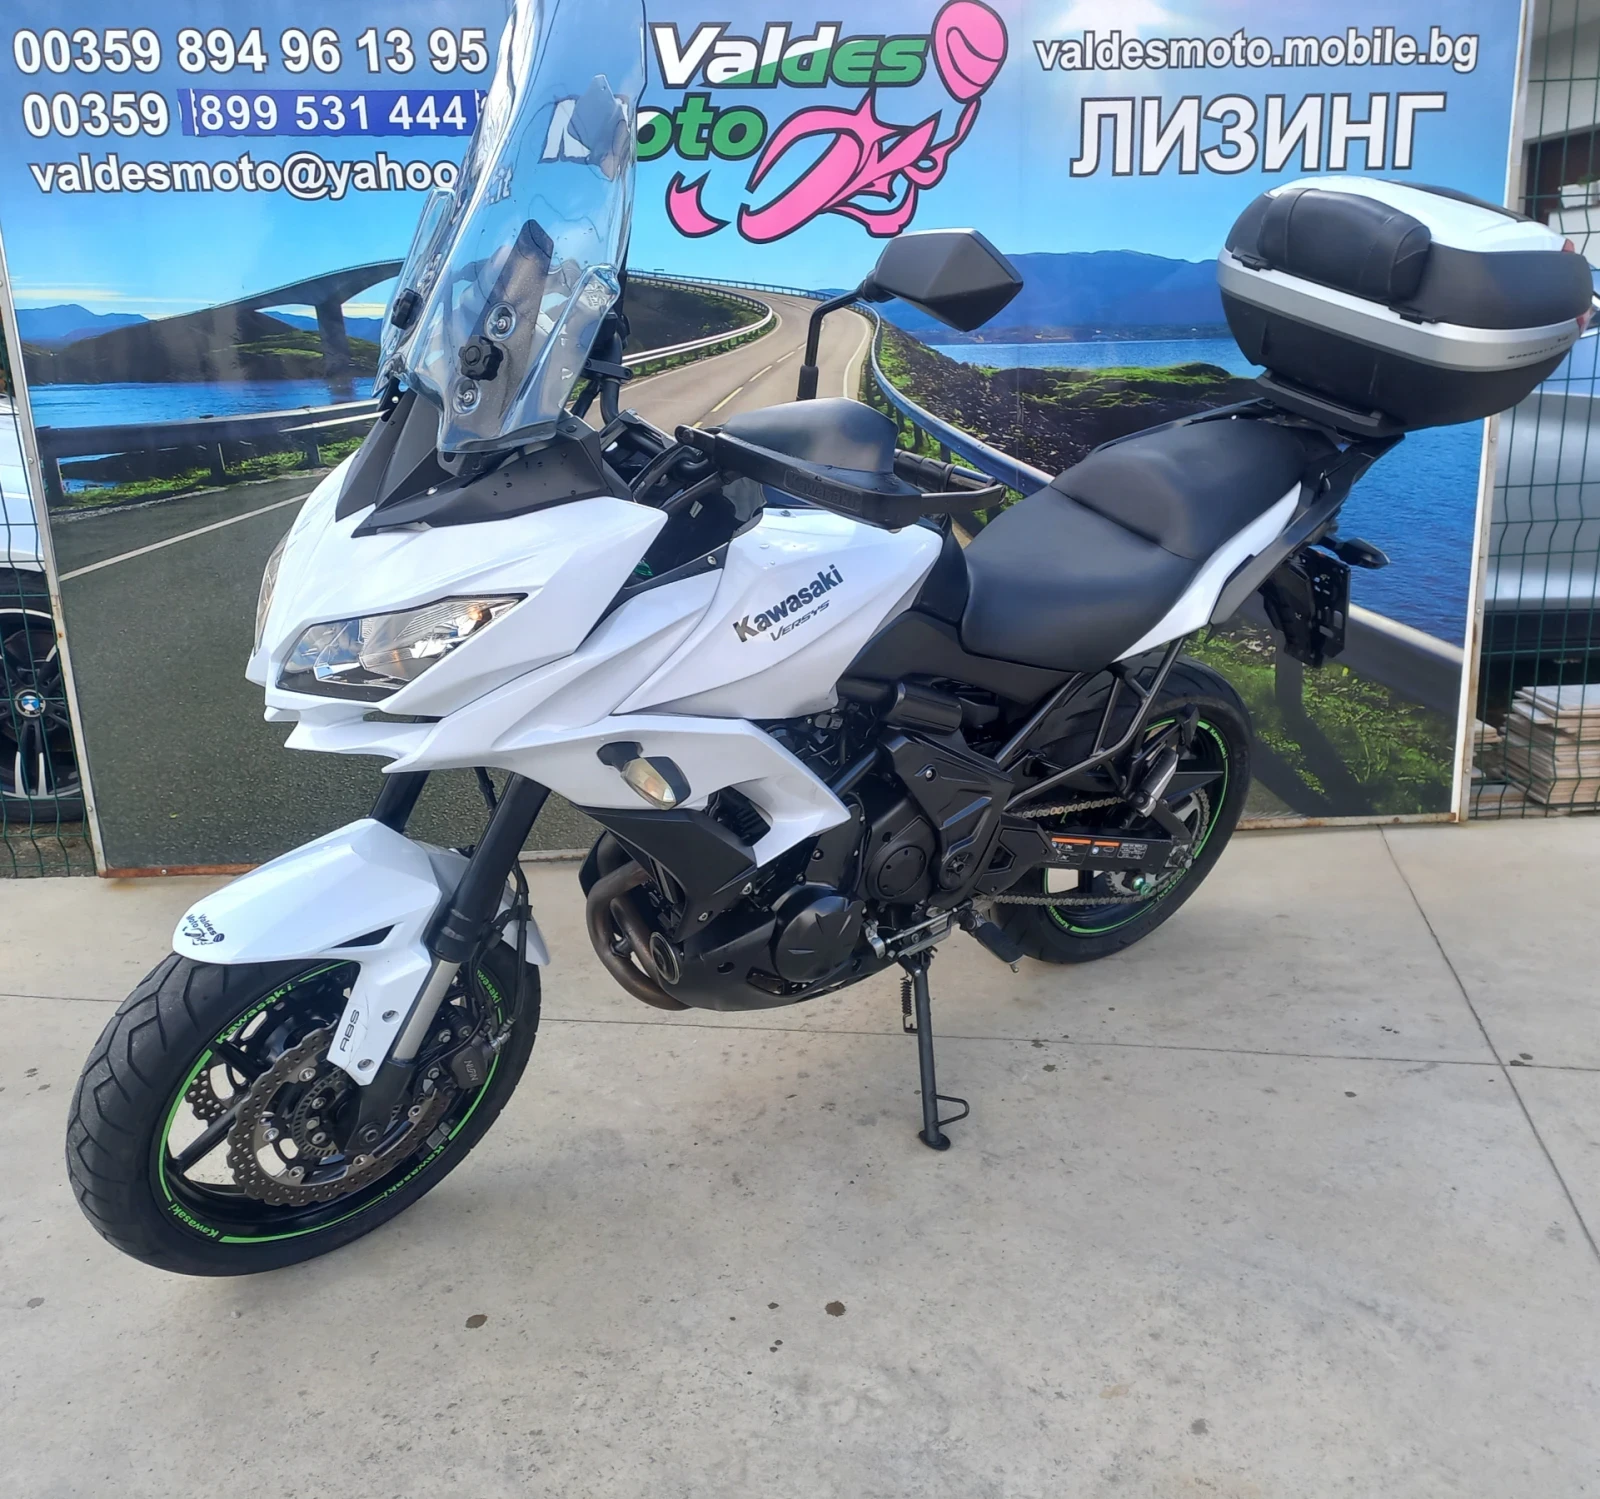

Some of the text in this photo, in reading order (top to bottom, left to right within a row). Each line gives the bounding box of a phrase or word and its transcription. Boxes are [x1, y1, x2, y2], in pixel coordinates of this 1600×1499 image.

[13, 27, 489, 74] 00359 894 96 13 95
[649, 21, 932, 88] Valdes
[1034, 27, 1479, 74] valdesmoto.mobile.bg
[23, 91, 467, 138] 00359 899 531 444
[1070, 92, 1446, 177] ЛИЗИНГ
[733, 564, 843, 642] Kawasaki
[770, 600, 830, 641] VERSYS
[215, 983, 294, 1045] Kawasaki
[339, 1009, 361, 1053] ABS
[168, 1203, 219, 1238] Kawasaki
